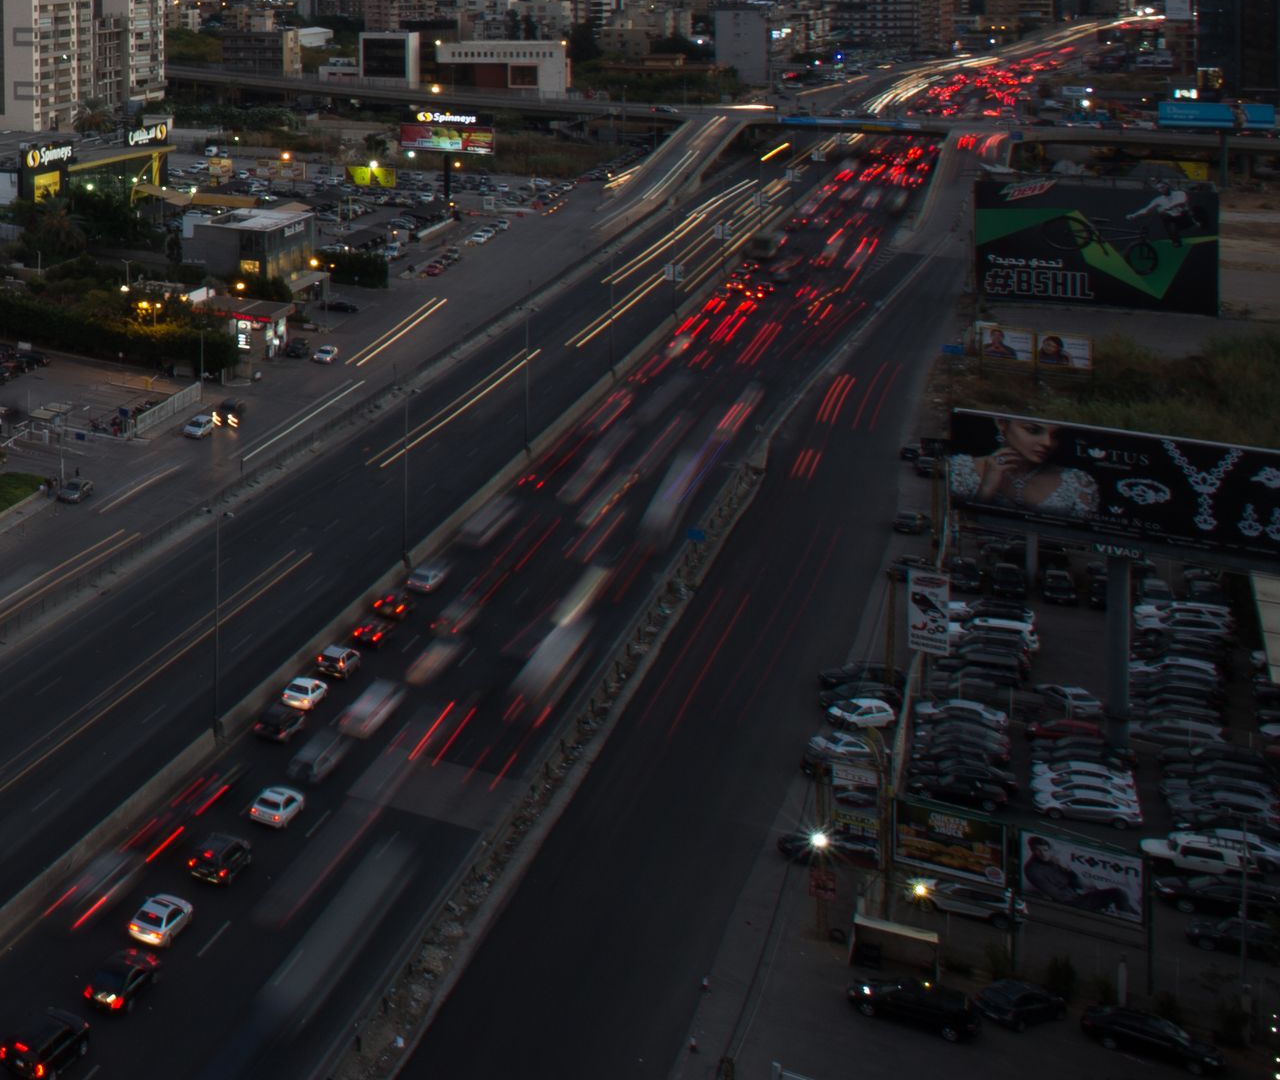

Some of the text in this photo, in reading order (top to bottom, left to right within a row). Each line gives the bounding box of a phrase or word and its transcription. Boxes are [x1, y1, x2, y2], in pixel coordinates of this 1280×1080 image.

[433, 112, 476, 124] Spinneys
[40, 145, 72, 166] Spinneys
[984, 268, 1095, 300] #BSHIL
[1071, 853, 1140, 878] KOTON
